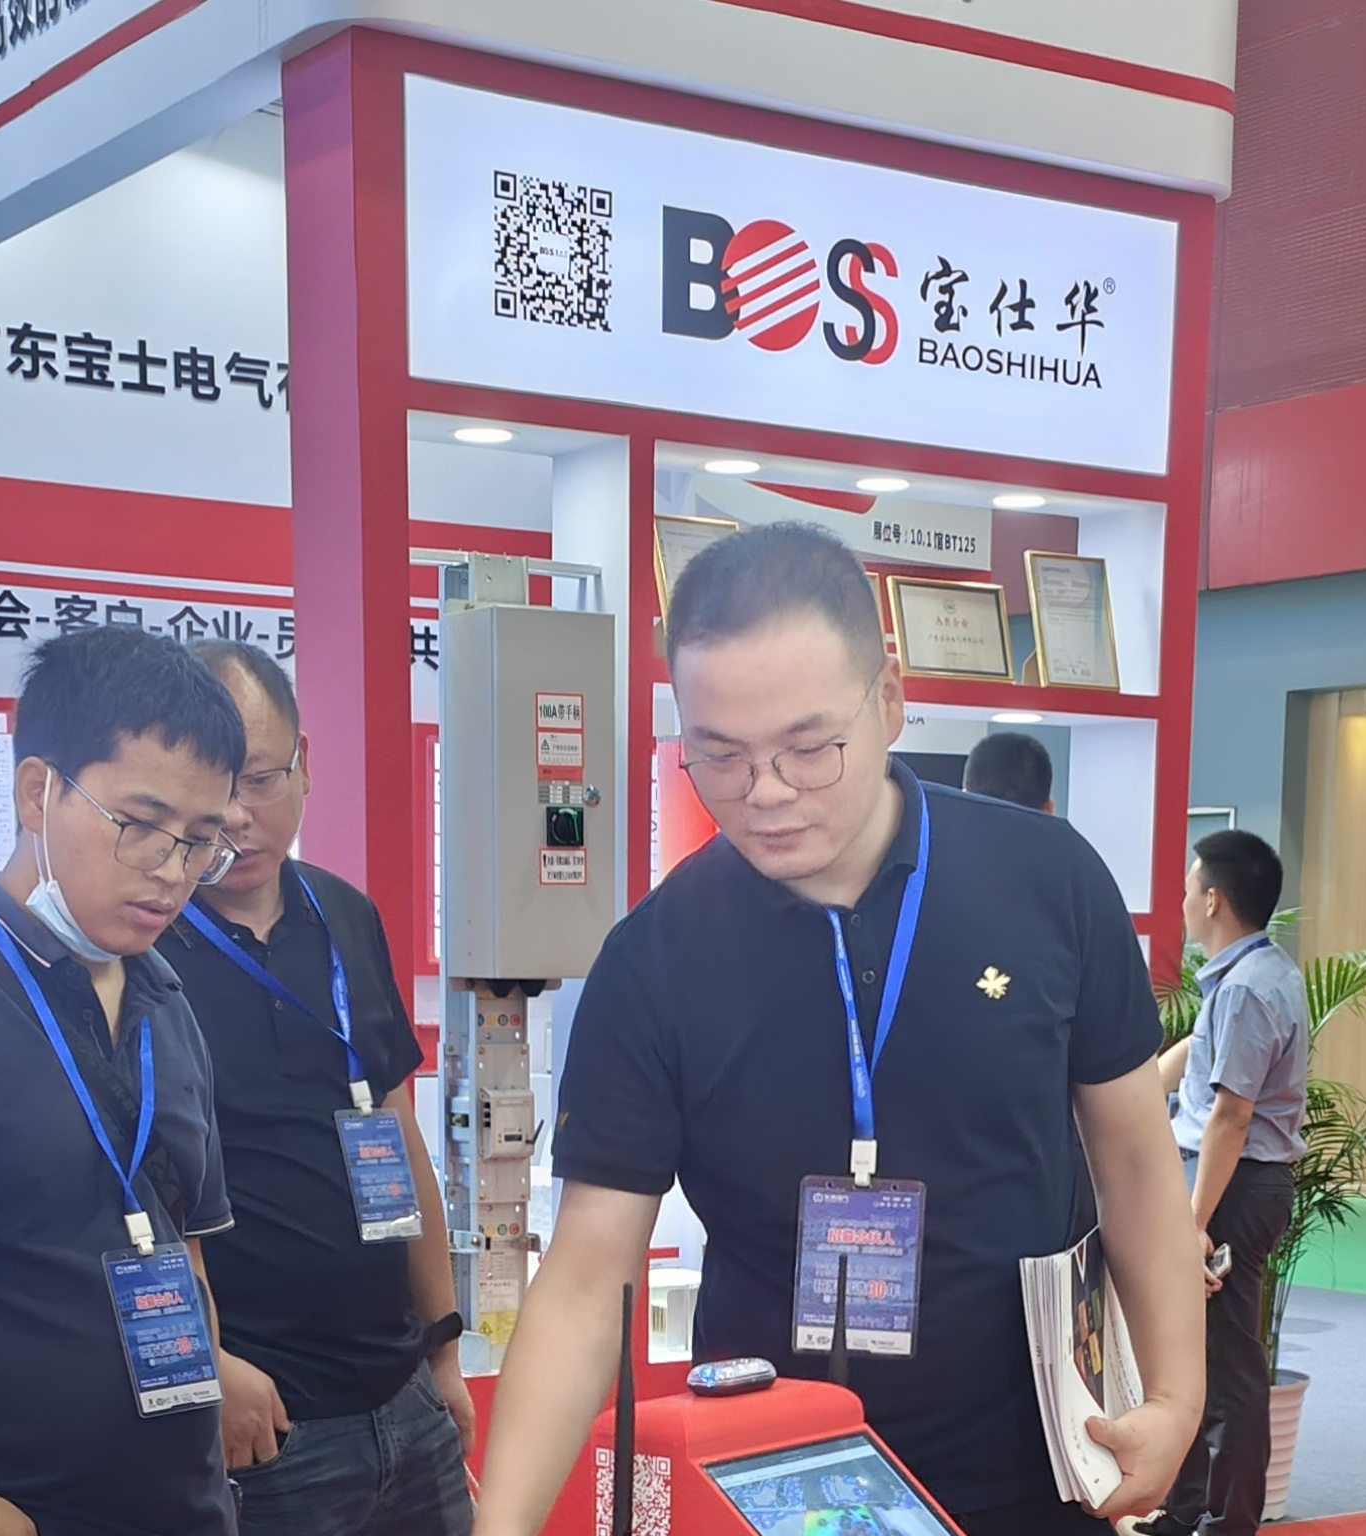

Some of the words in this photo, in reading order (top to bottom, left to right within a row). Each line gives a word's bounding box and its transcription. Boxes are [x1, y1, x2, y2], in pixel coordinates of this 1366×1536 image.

[919, 256, 1105, 356] 宝仕华
[918, 338, 1103, 389] BAOSHIHUA
